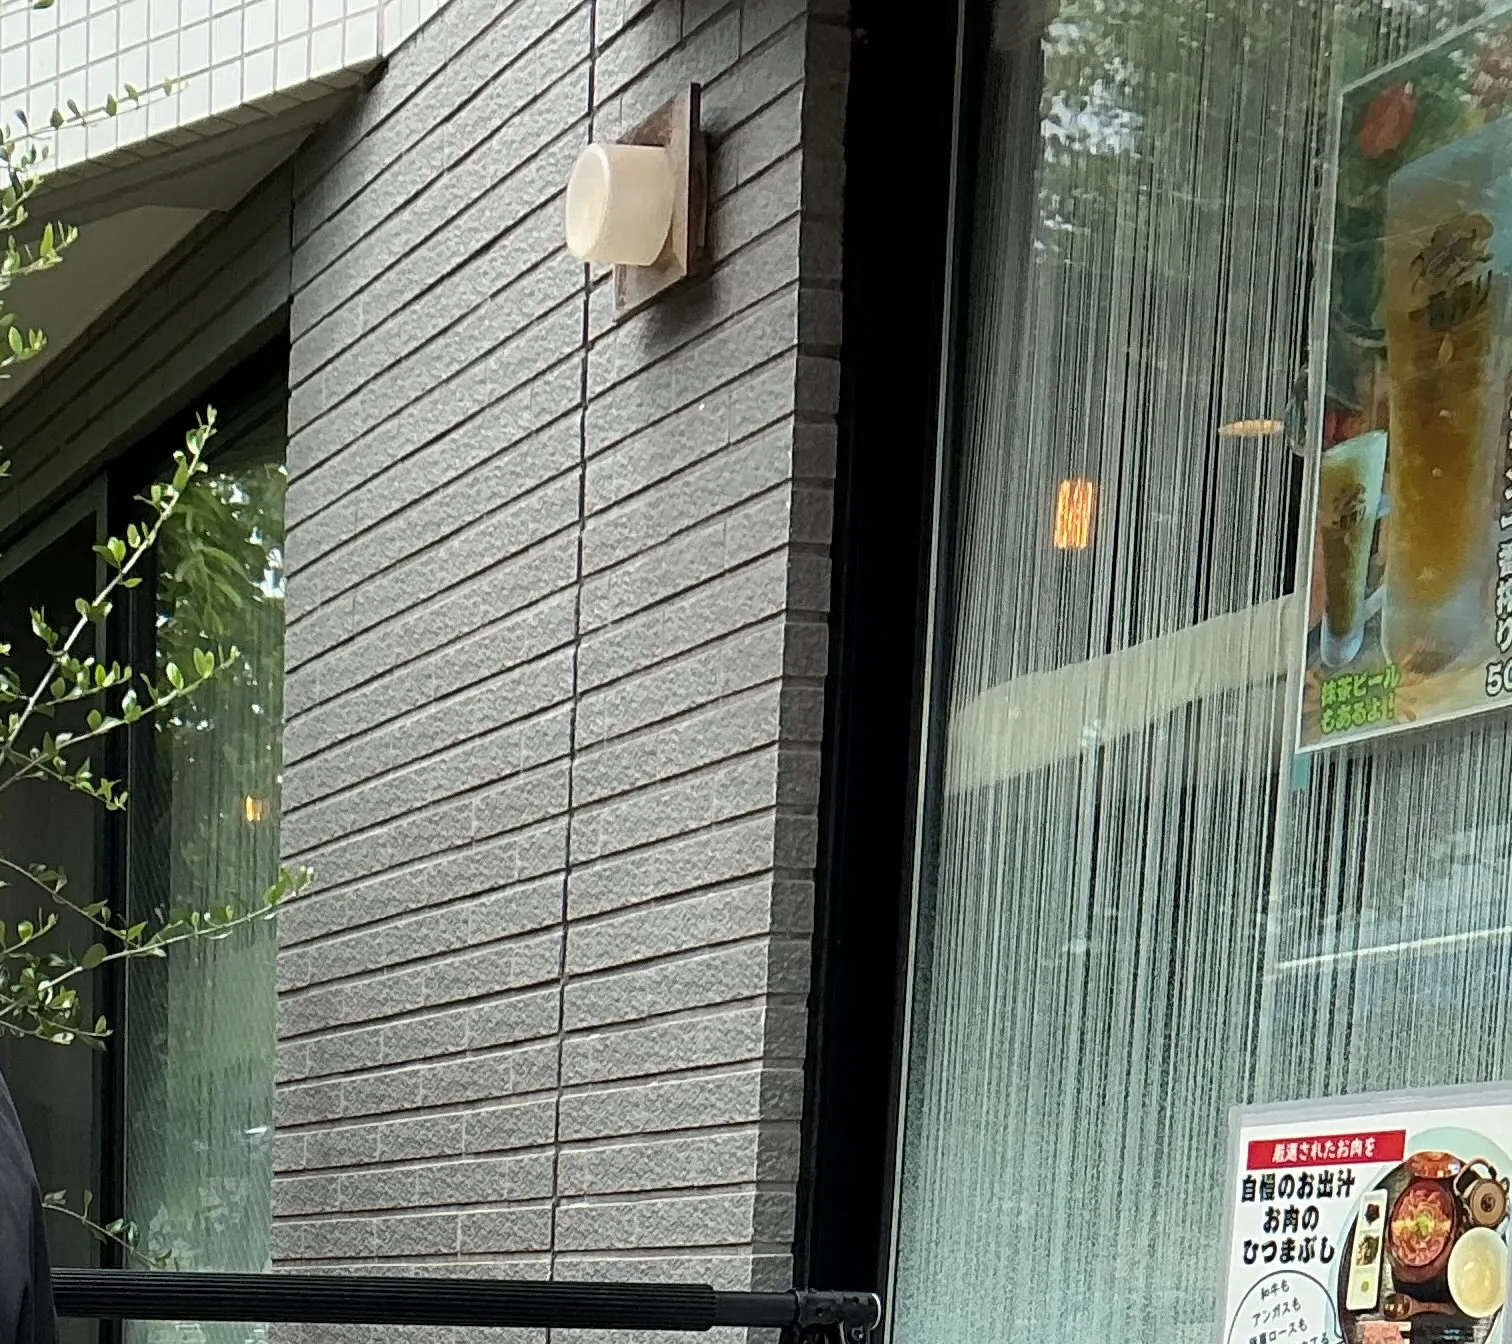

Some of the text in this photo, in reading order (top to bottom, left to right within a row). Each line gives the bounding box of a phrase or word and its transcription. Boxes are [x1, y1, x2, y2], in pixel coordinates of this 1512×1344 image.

[1241, 1168, 1356, 1203] 自慢のお出汁
[1262, 1204, 1320, 1234] お肉の
[1243, 1235, 1335, 1265] ひつまぶし
